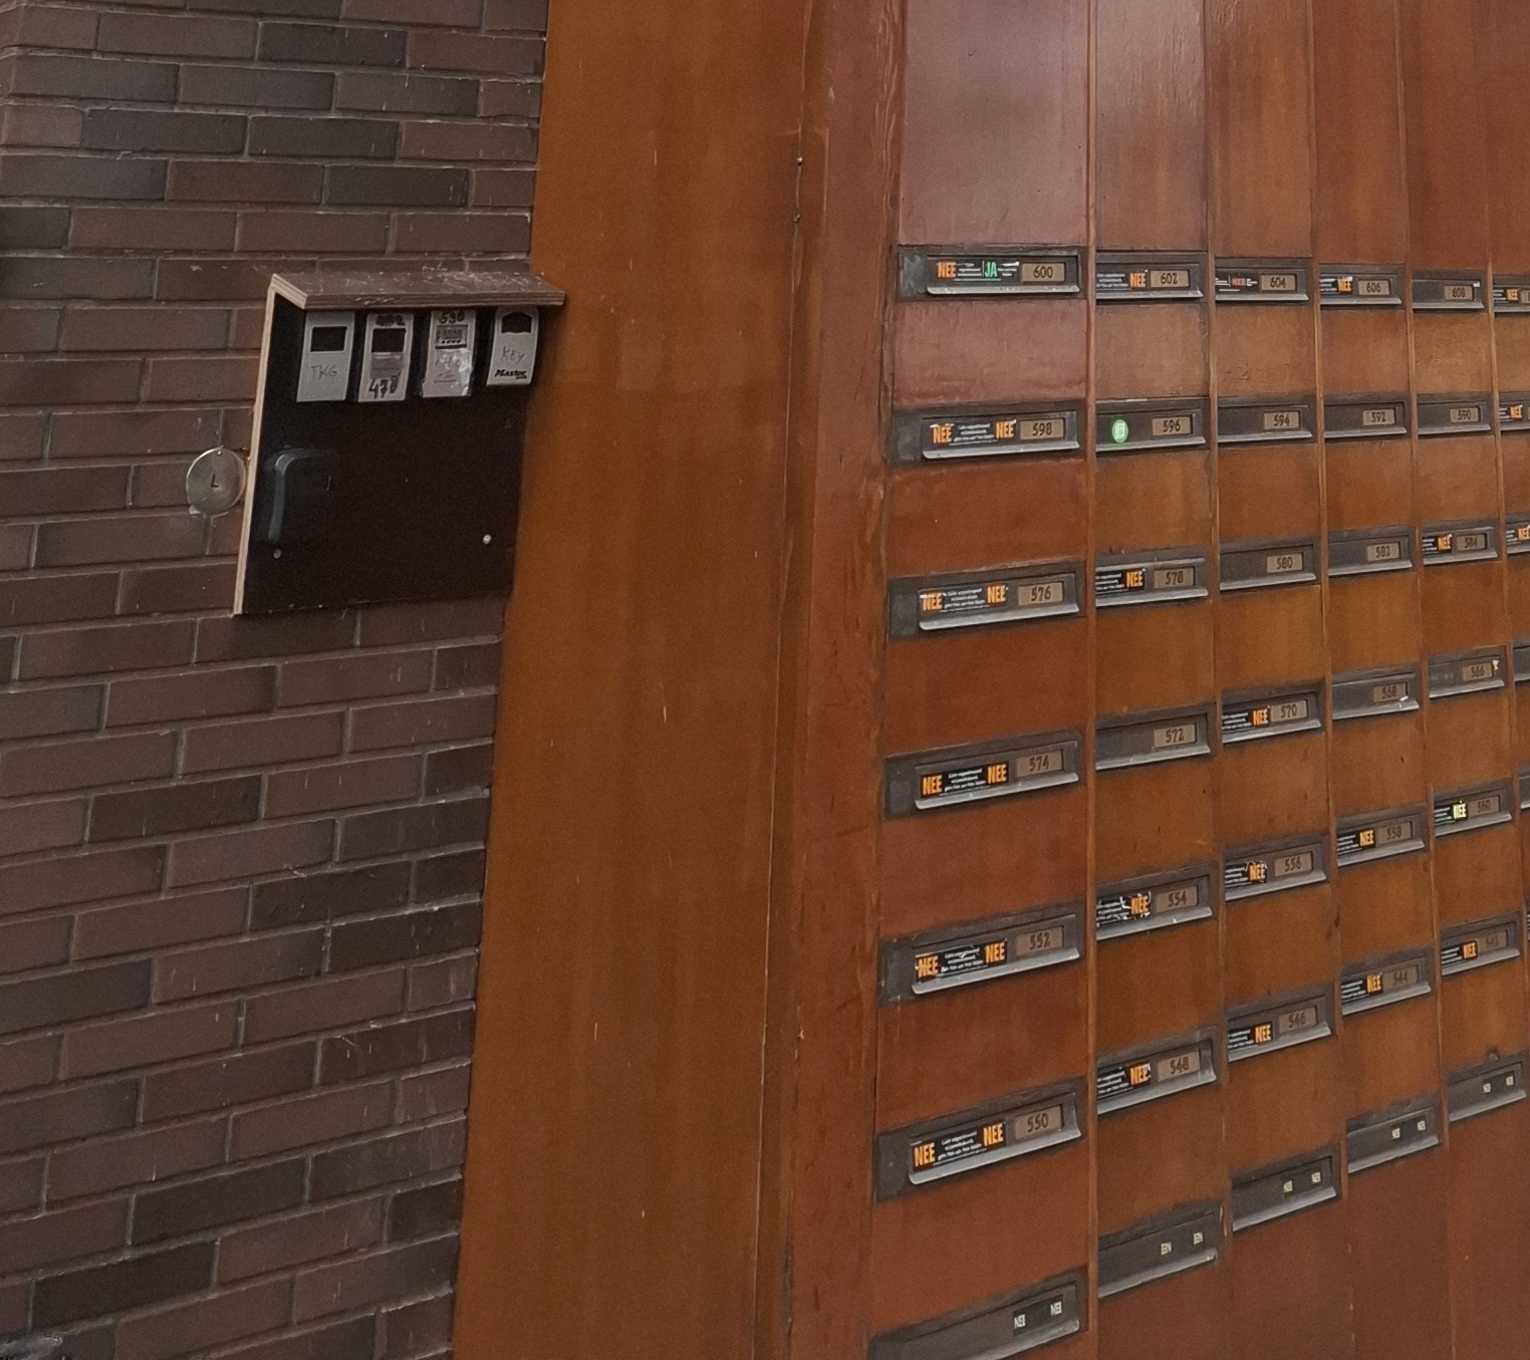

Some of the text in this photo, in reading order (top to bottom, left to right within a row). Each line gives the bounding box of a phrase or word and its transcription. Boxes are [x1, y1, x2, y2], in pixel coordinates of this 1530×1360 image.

[936, 261, 957, 278] NEE
[984, 262, 998, 277] JA
[1033, 266, 1054, 279] 600
[1160, 273, 1178, 285] 602
[1270, 275, 1286, 288] 604
[1163, 419, 1181, 433] 596
[1273, 413, 1290, 427] 594
[996, 421, 1014, 440] NEE
[1032, 423, 1053, 437] 598
[1276, 556, 1294, 570] 580
[1166, 570, 1184, 585] 578
[987, 585, 1007, 604] NEE
[1031, 585, 1051, 602] 576
[1280, 704, 1298, 719] 570
[1165, 727, 1185, 743] 572
[922, 775, 943, 796] NEE
[987, 764, 1007, 785] NEE
[1029, 755, 1050, 772] 574
[1168, 890, 1187, 907] 554
[918, 956, 939, 978] NEE
[985, 942, 1006, 963] NEE
[1029, 932, 1051, 950] 552
[1170, 1057, 1190, 1075] 548
[914, 1142, 936, 1167] NEE
[983, 1123, 1004, 1146] NEE
[1027, 1113, 1049, 1133] 550
